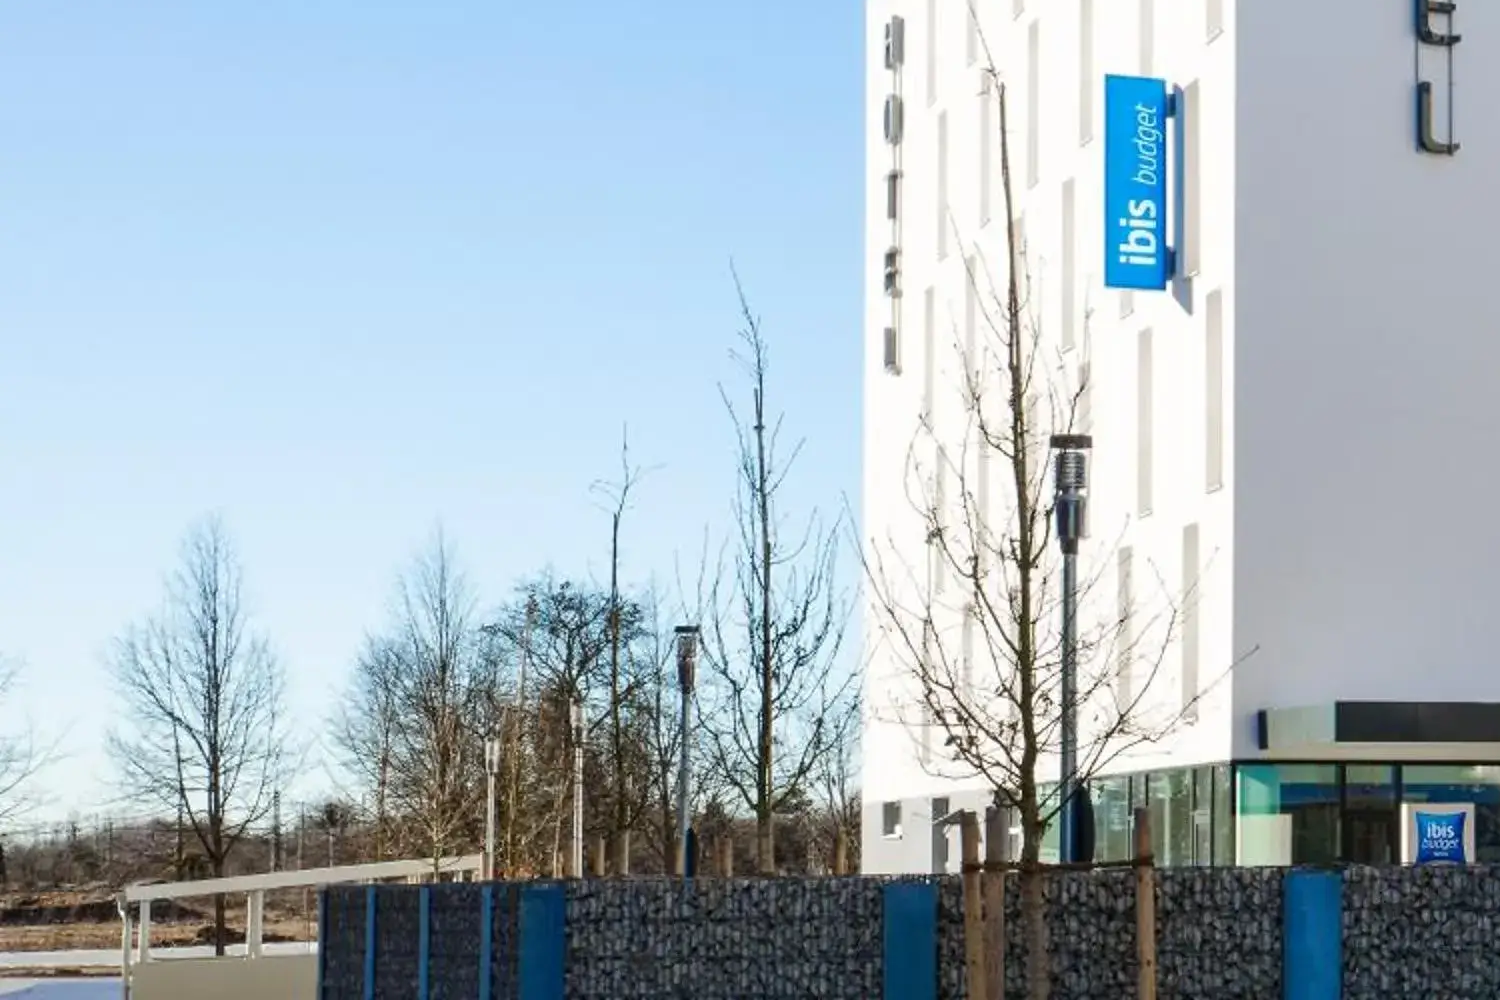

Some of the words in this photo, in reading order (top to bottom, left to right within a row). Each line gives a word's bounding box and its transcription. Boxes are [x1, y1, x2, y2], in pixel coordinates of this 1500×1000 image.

[1131, 103, 1164, 185] budget
[1119, 199, 1157, 266] ibis
[1427, 822, 1456, 839] ibis
